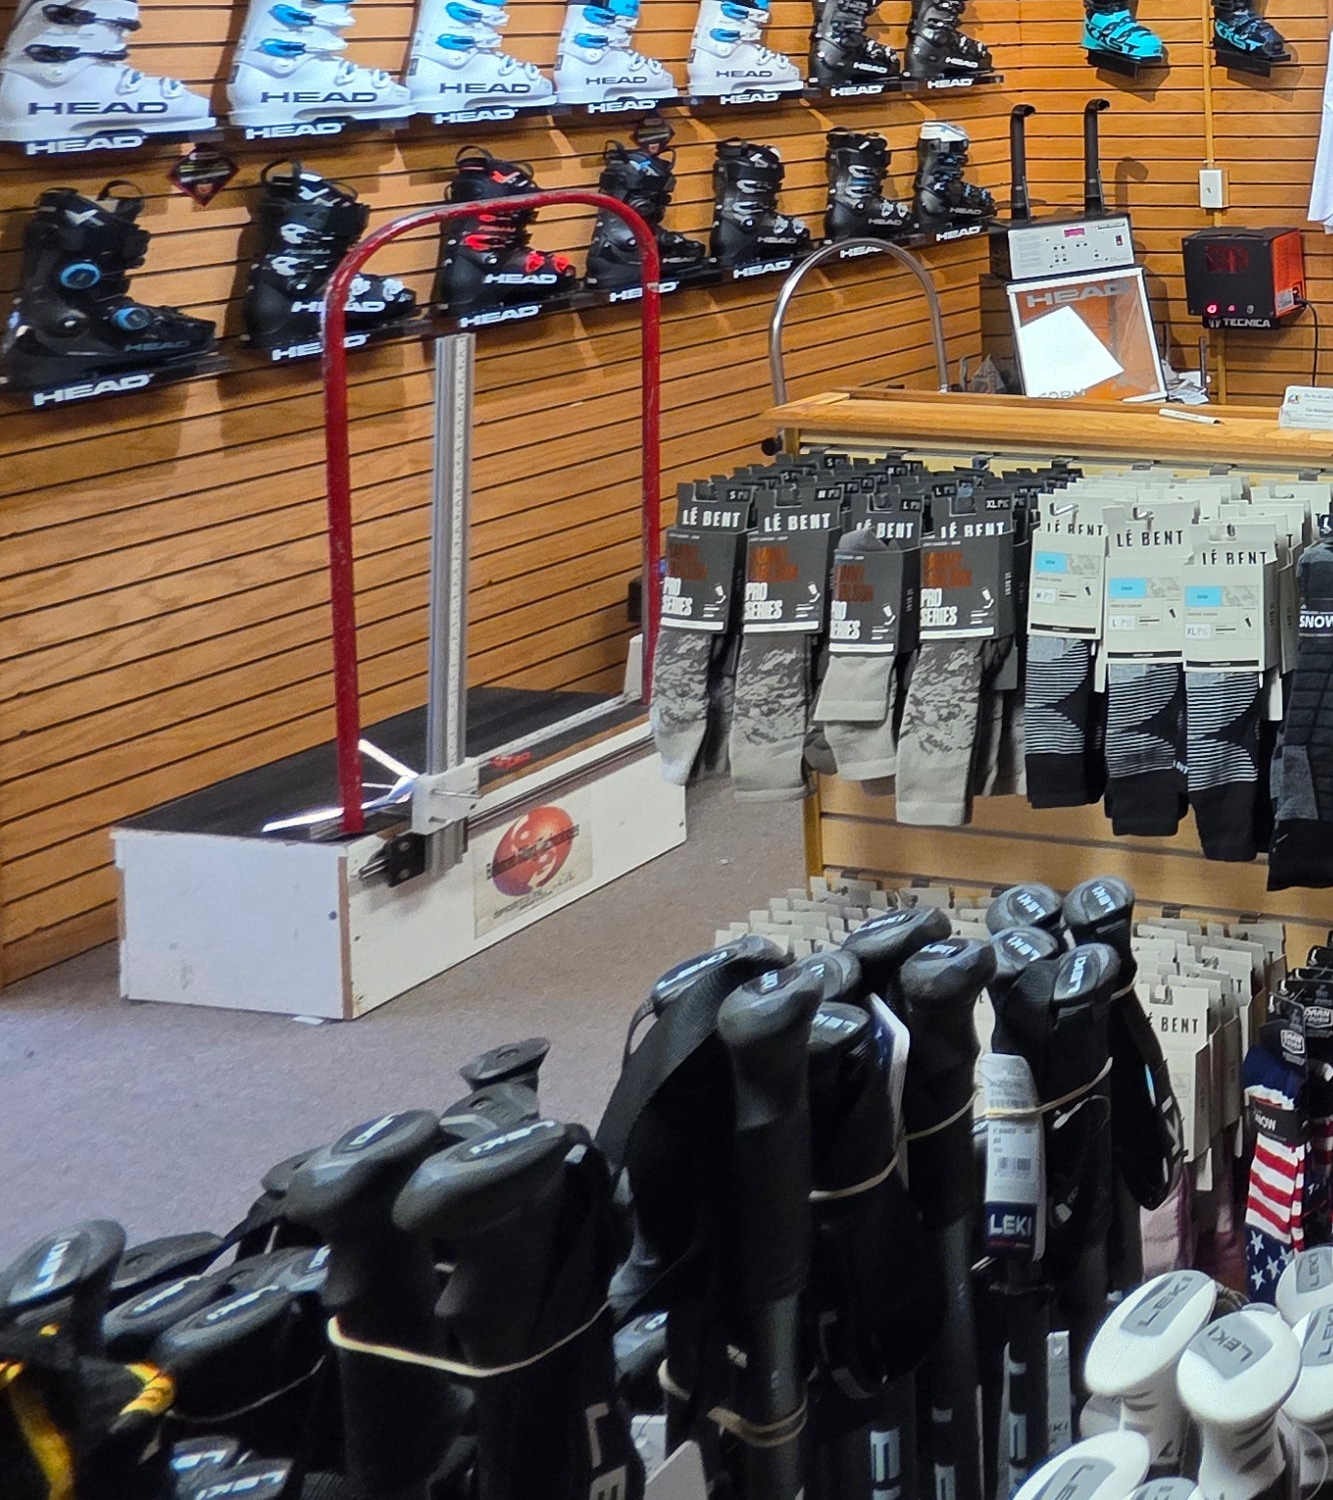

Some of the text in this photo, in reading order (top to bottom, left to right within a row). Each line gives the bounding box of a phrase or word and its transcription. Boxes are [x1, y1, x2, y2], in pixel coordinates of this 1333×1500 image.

[716, 70, 773, 78] HEAD
[853, 62, 888, 73] HEAD
[439, 82, 531, 94] HEAD
[586, 76, 647, 85] HEAD
[928, 77, 973, 88] HEAD
[260, 91, 377, 103] HEAD
[720, 91, 780, 104] HEAD
[831, 84, 884, 97] HEAD
[28, 101, 168, 116] HEAD
[588, 99, 656, 113] HEAD
[434, 109, 516, 125] HEAD
[245, 123, 343, 140] HEAD
[25, 135, 145, 156] HEAD
[936, 225, 982, 241] HEAD
[840, 245, 884, 258] HEA
[733, 260, 792, 279] HEAD
[484, 273, 557, 285] HEAD
[609, 281, 678, 302] HED
[1027, 281, 1130, 307] HEAD
[460, 304, 541, 328] HEAD
[1223, 317, 1271, 328] TECNICA
[272, 334, 369, 361] HED
[33, 373, 152, 406] HEAD
[702, 512, 741, 528] BENT
[788, 513, 830, 531] BENT
[876, 522, 914, 539] BENT
[1141, 530, 1184, 546] BENT
[661, 598, 693, 616] SERIES
[744, 600, 783, 620] SERIES
[920, 607, 957, 627] SERIES
[829, 621, 860, 639] SERIES
[1160, 1015, 1200, 1035] BENT
[990, 1213, 1033, 1238] LEKI
[1307, 1250, 1321, 1290] LEKI
[1137, 1275, 1194, 1329] LEKI
[1203, 1325, 1257, 1366] LEKI
